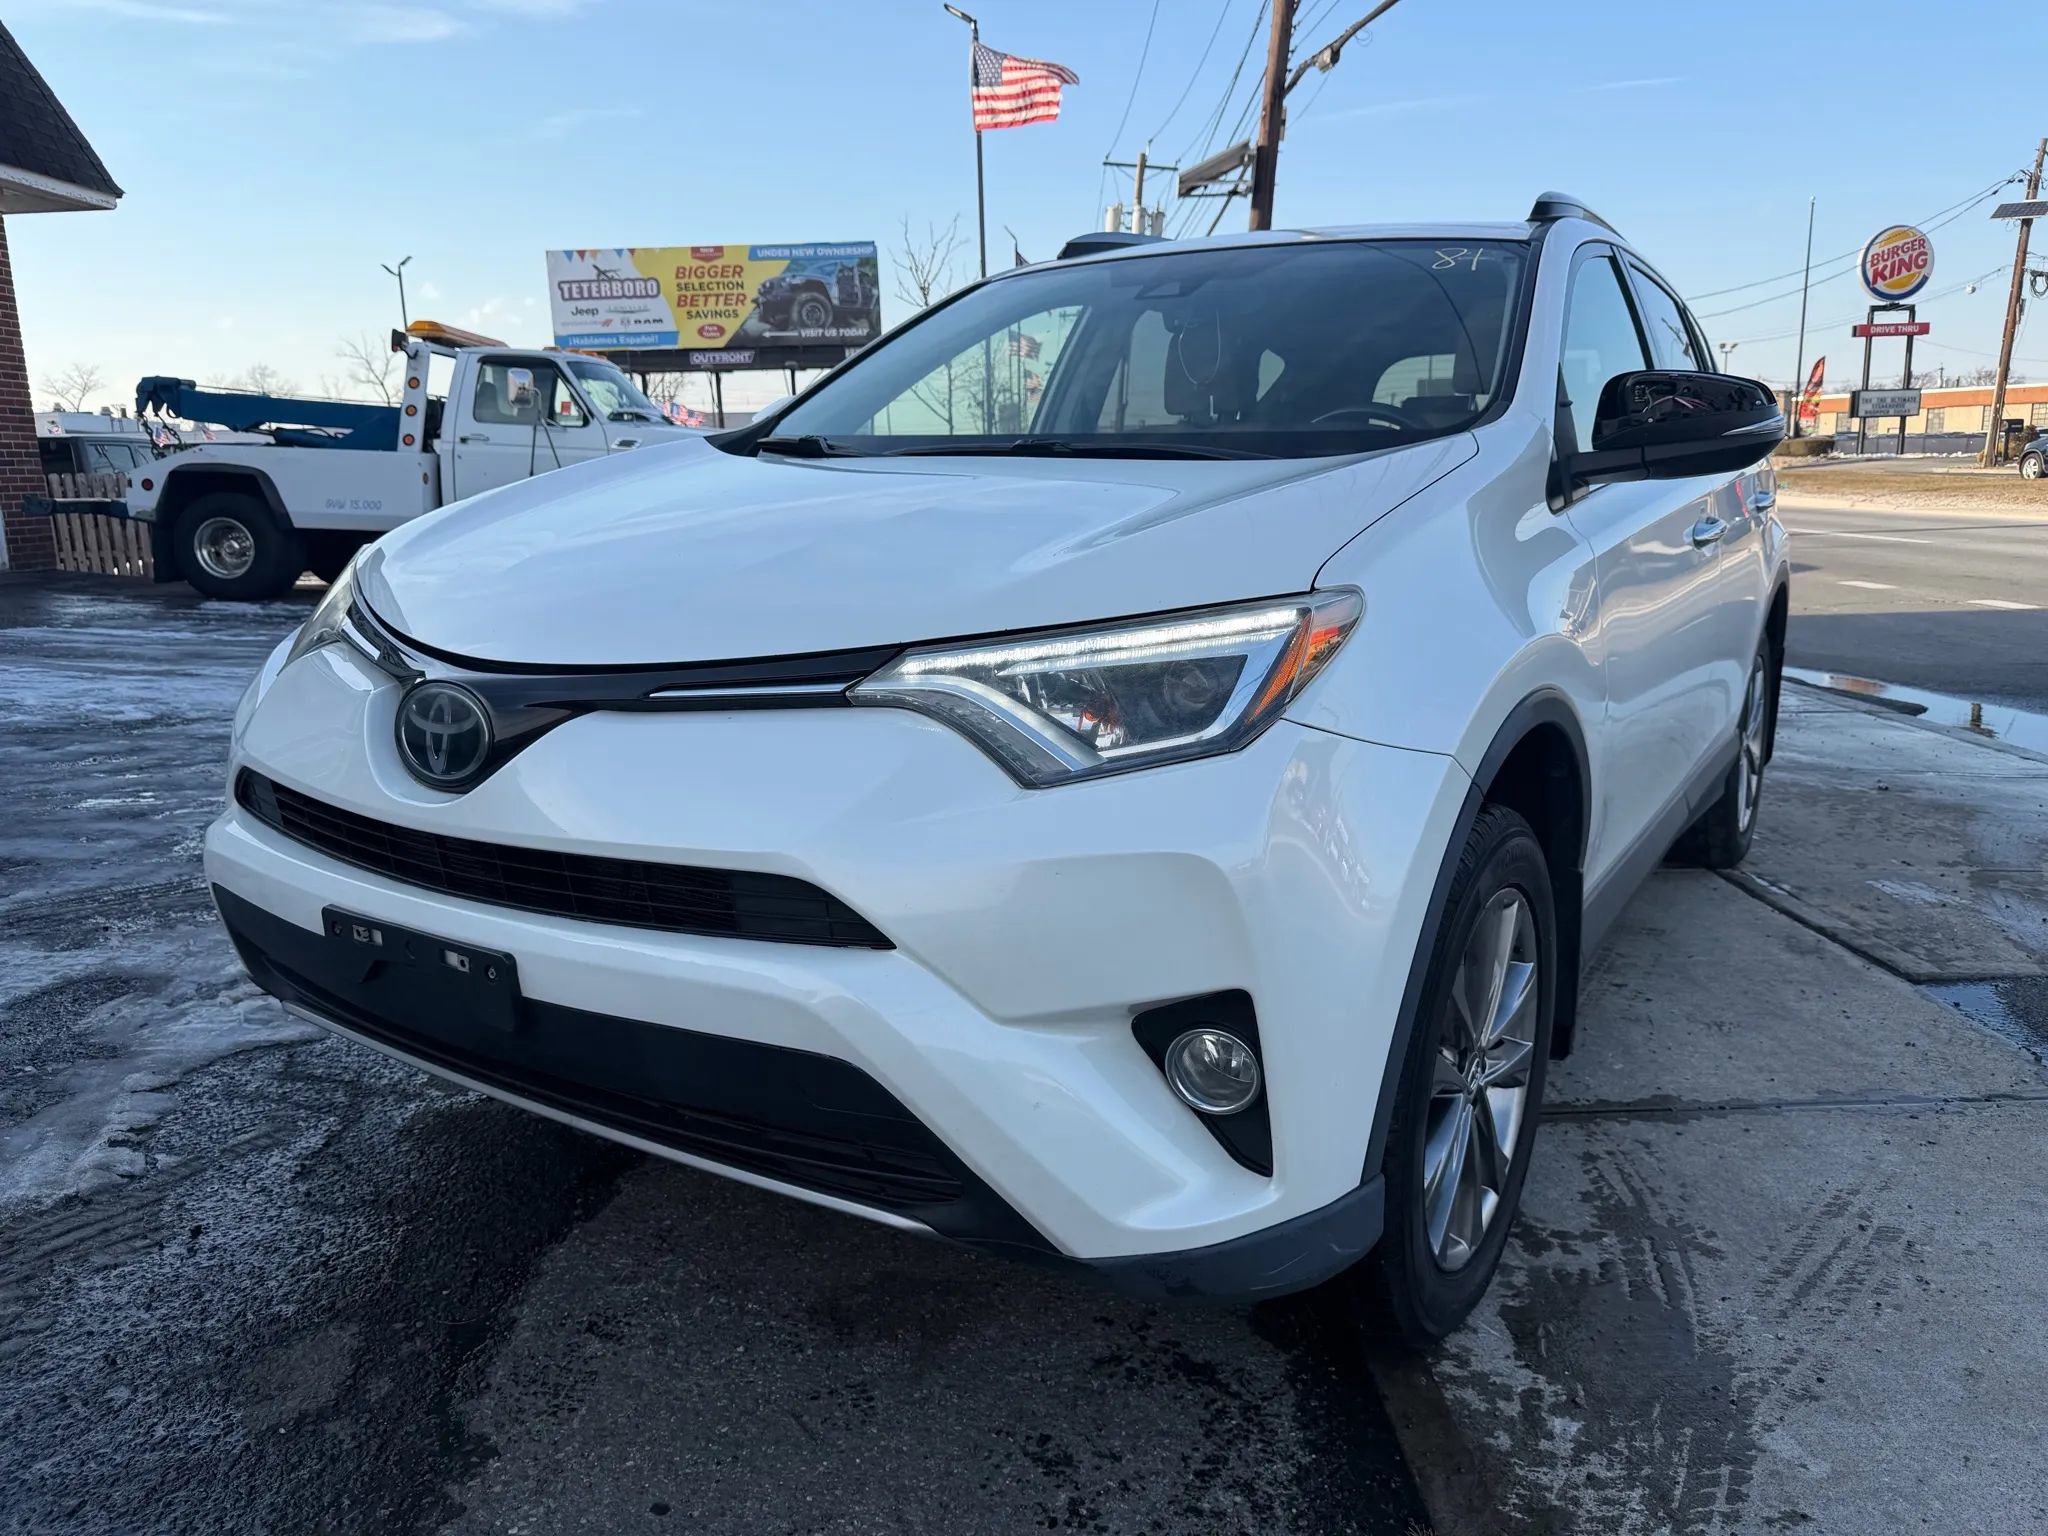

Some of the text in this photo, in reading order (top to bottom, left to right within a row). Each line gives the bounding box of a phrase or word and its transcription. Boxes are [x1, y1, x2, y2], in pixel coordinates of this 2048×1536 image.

[756, 246, 874, 257] UNDER NEW OWNERSHIP
[1870, 237, 1926, 267] BURGER
[675, 264, 744, 279] BIGGER
[1871, 251, 1929, 286] KING
[559, 279, 659, 300] TETERBORO
[676, 281, 744, 292] SELECTION
[677, 293, 747, 308] BETTER
[570, 306, 599, 317] Jeep
[686, 309, 739, 320] SAVINGS
[800, 327, 870, 338] VISIT US TODAY
[1870, 324, 1919, 334] DRIVE THRU
[692, 350, 752, 363] OUTFRONT
